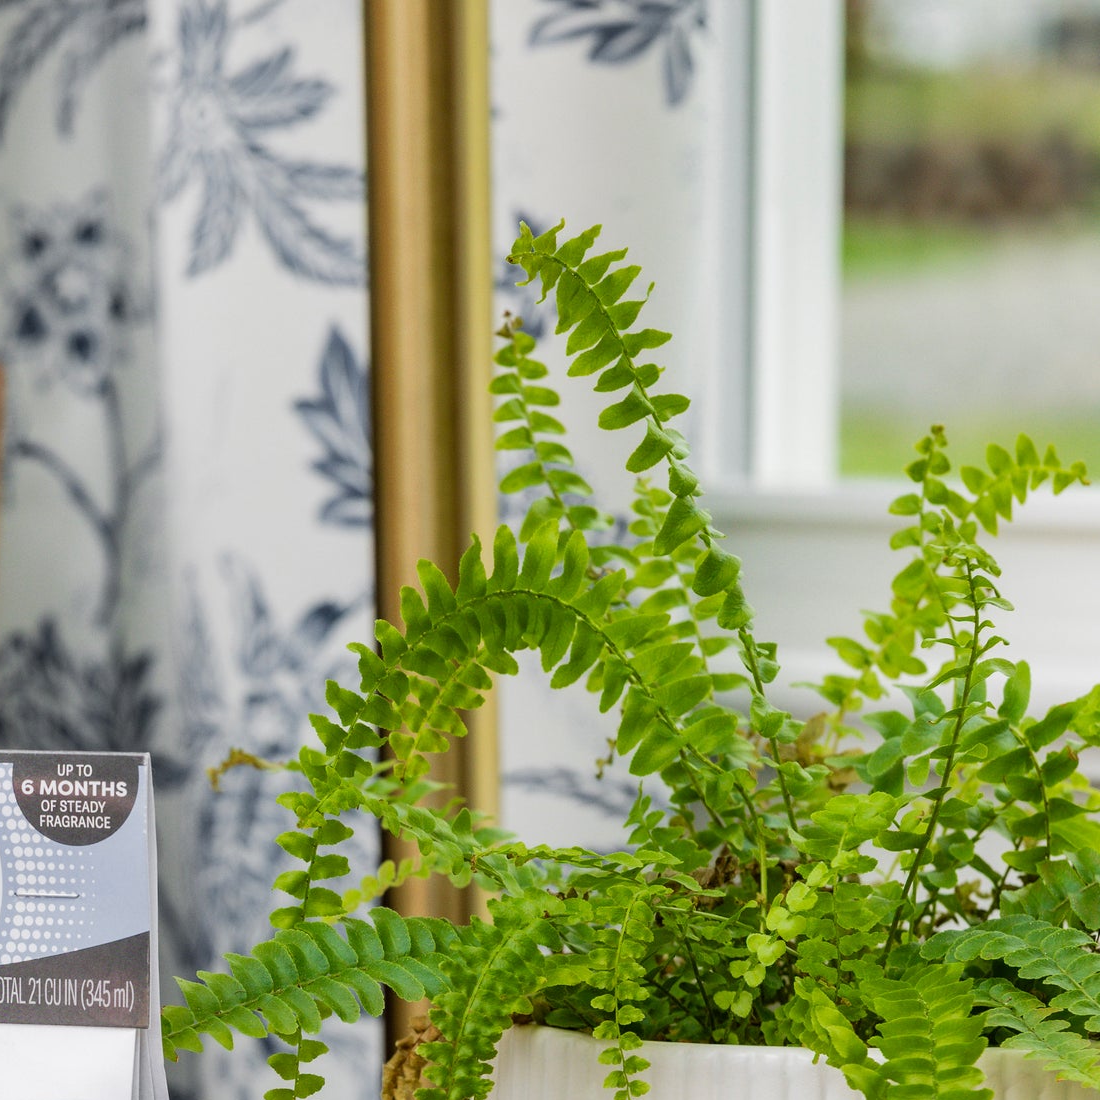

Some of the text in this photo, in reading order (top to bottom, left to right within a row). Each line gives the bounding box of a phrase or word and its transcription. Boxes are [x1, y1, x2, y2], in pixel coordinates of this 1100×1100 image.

[57, 764, 93, 777] UP TO
[21, 779, 128, 797] 6 MONTHS
[41, 799, 106, 813] OF STEADY
[40, 815, 111, 829] FRAGRANCE
[28, 976, 43, 1005] 21
[45, 977, 60, 1006] CU
[64, 979, 76, 1007] IN
[81, 978, 111, 1011] (345
[113, 980, 135, 1012] ml)
